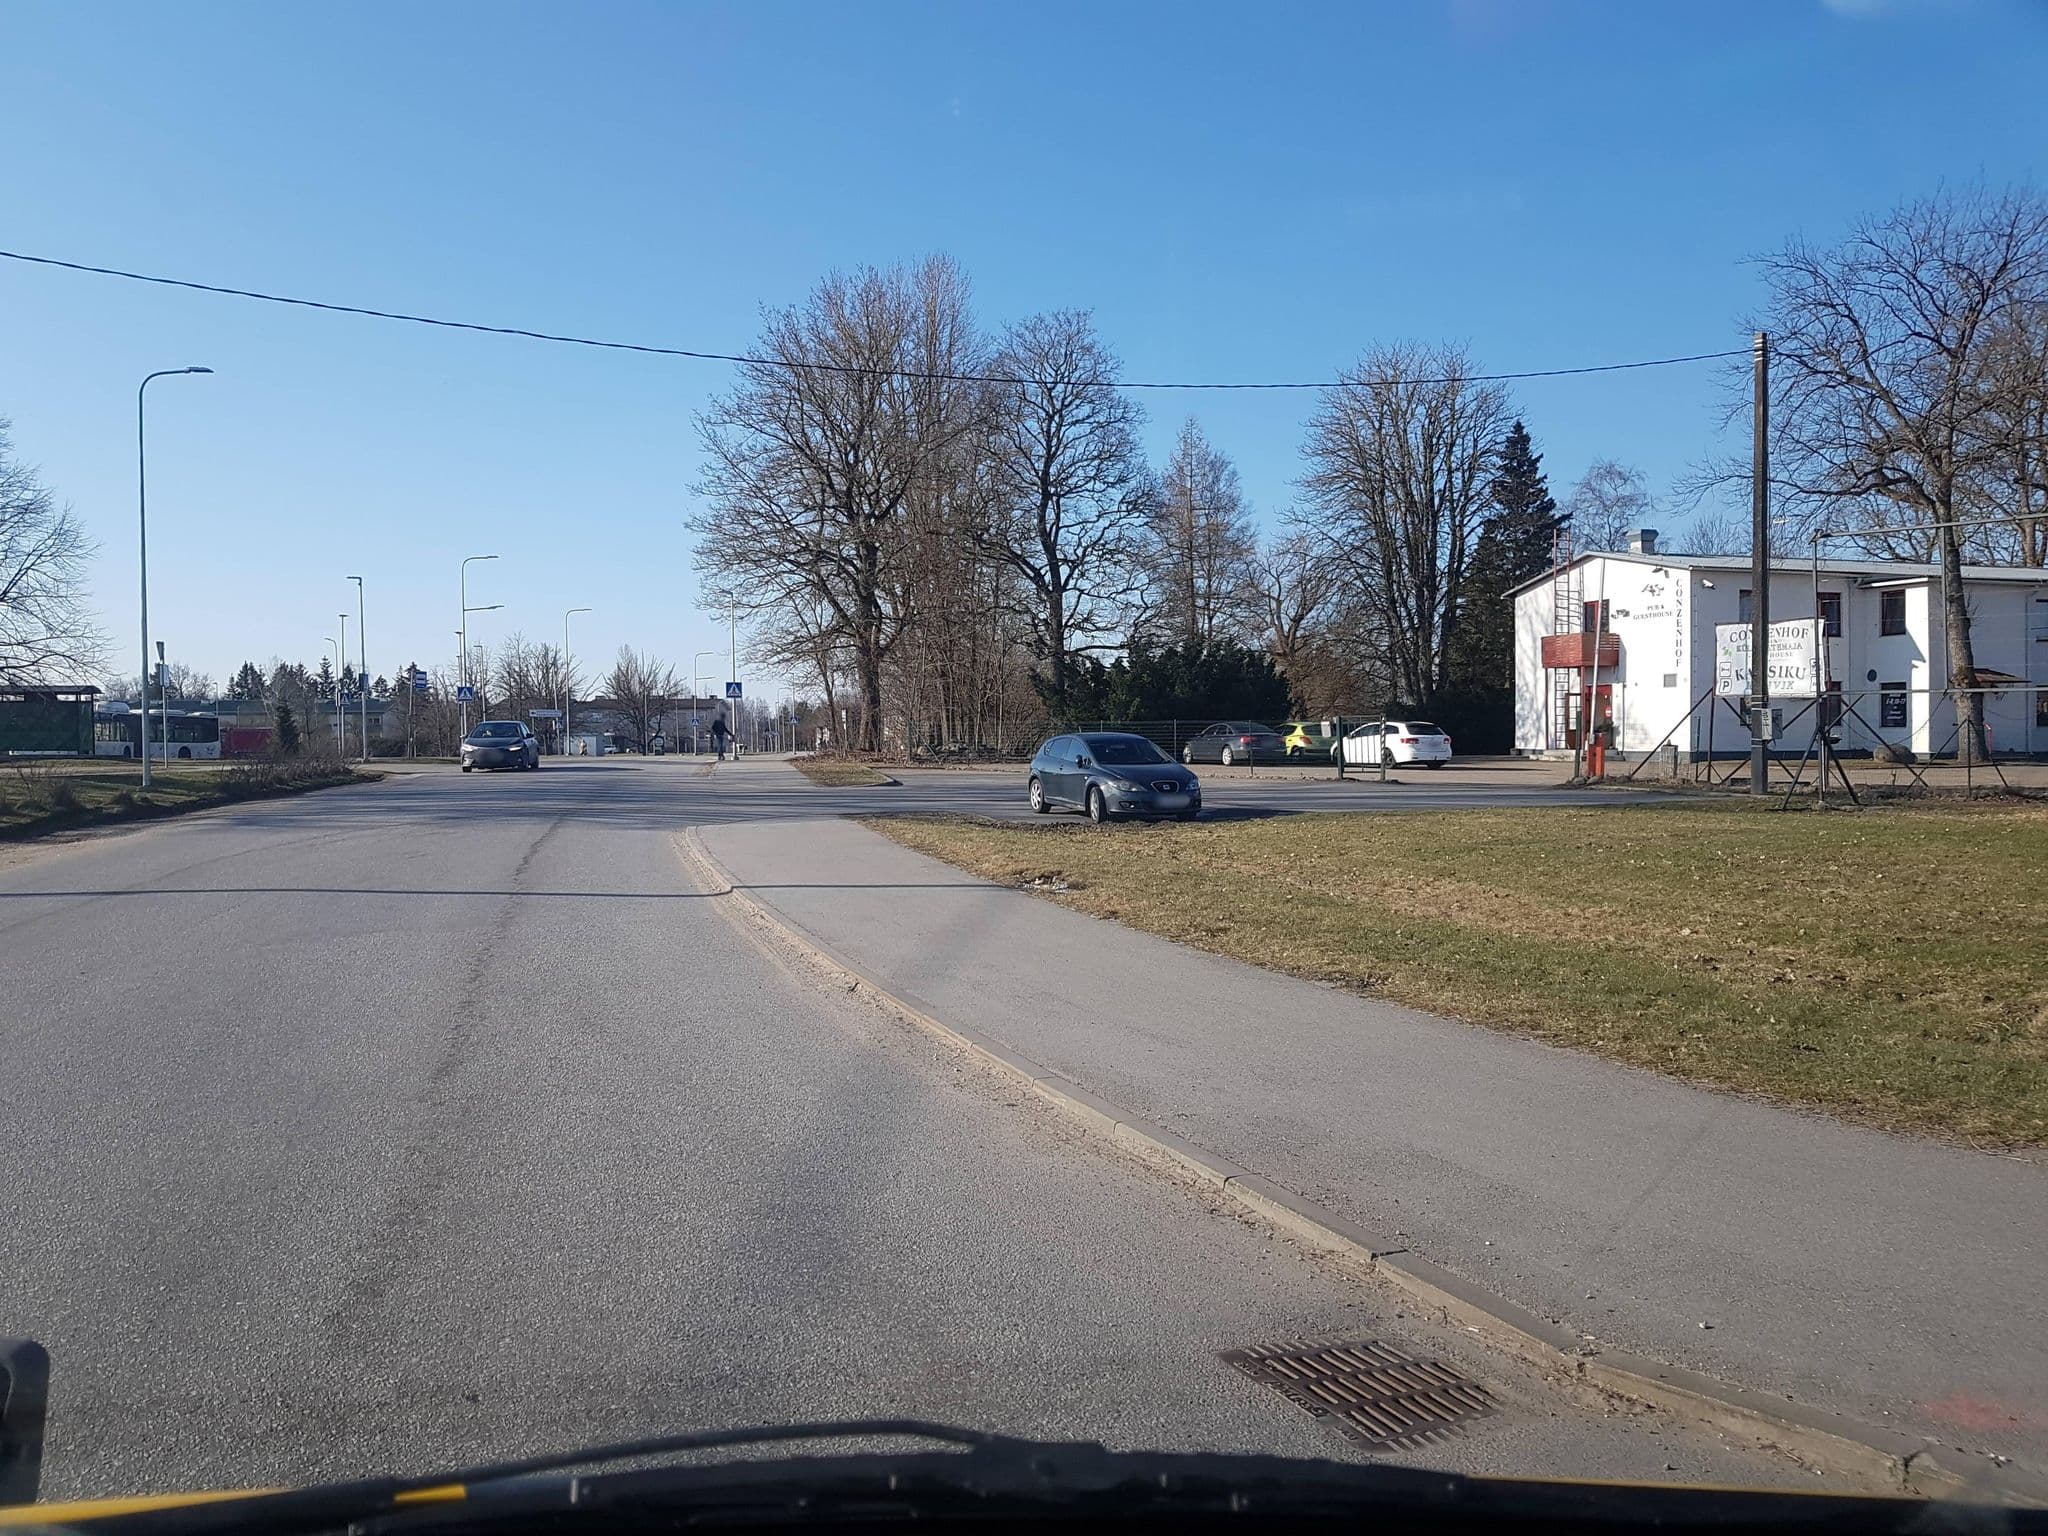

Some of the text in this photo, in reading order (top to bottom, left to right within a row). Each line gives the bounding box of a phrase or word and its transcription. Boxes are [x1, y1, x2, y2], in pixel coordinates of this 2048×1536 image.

[1632, 611, 1674, 620] GUESTHOUSE
[1675, 578, 1683, 667] CONZENHOF
[1730, 625, 1809, 643] COENHOF
